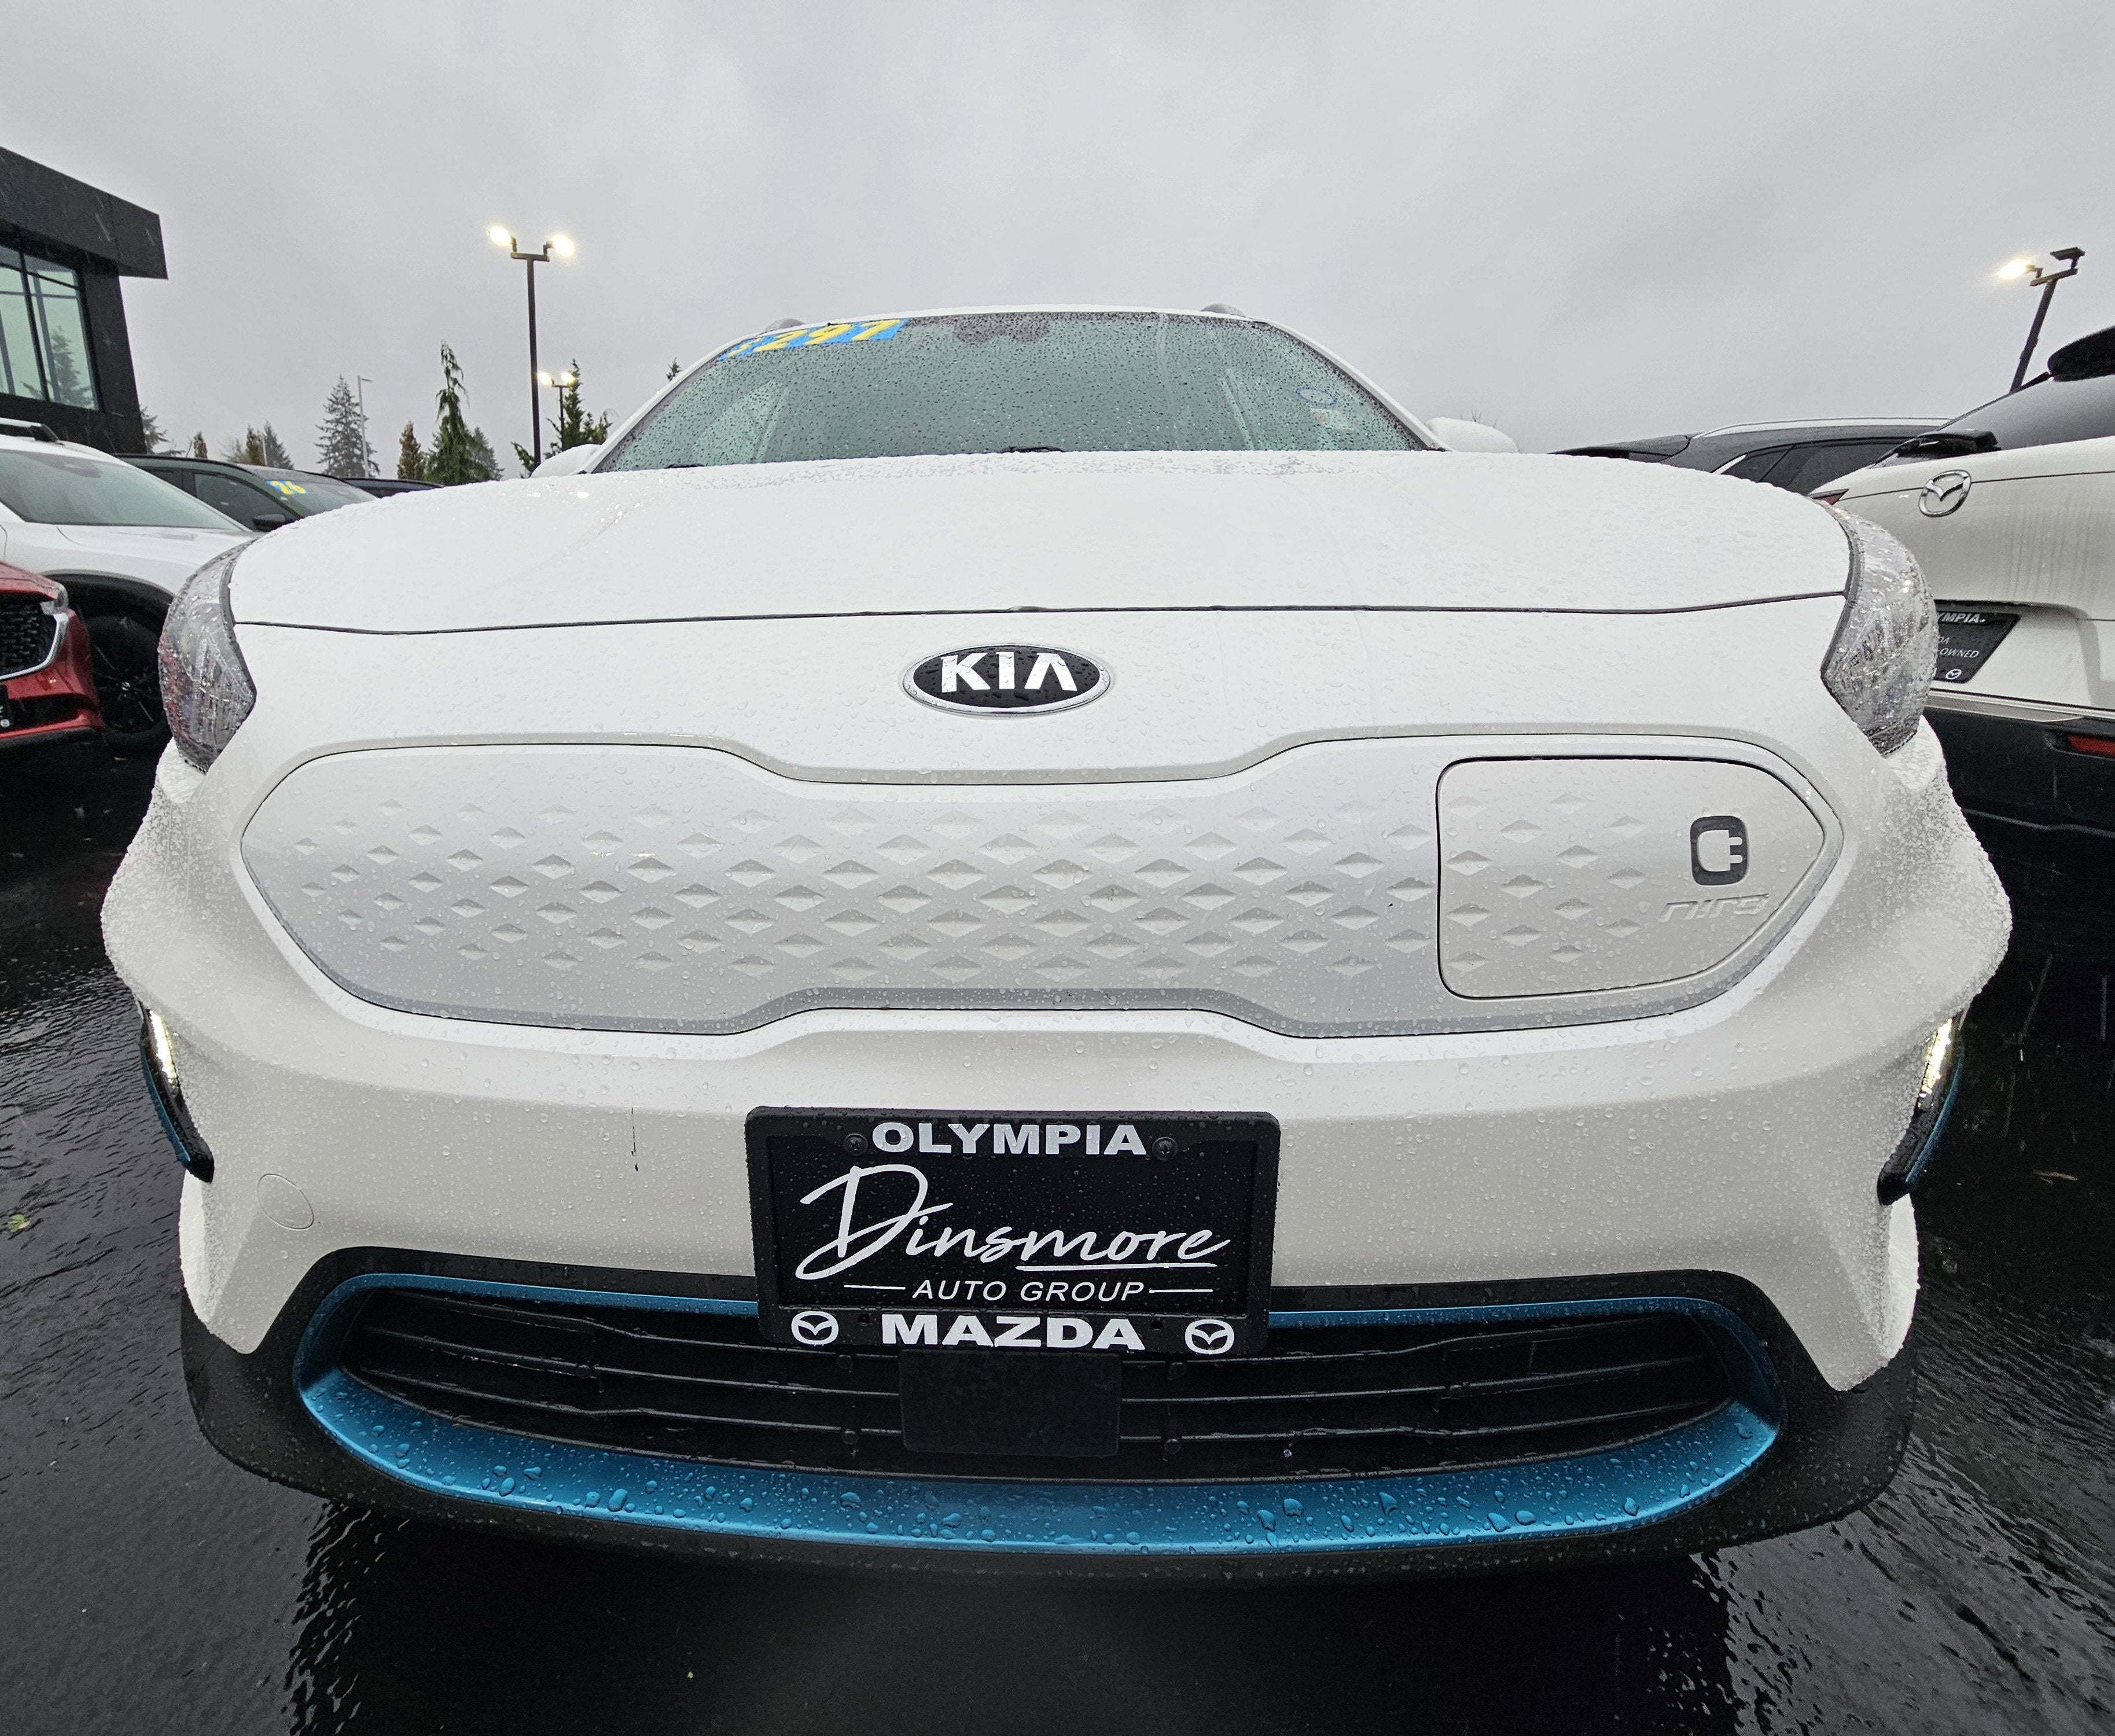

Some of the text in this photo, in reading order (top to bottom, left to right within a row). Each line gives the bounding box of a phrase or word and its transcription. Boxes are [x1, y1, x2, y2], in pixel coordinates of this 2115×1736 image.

[941, 652, 1077, 692] KIA
[872, 1122, 1147, 1155] OLYMPIA
[795, 1164, 1231, 1280] Dinsmore
[912, 1279, 1145, 1301] AUTO GROUP
[881, 1314, 1146, 1351] MAZDA
